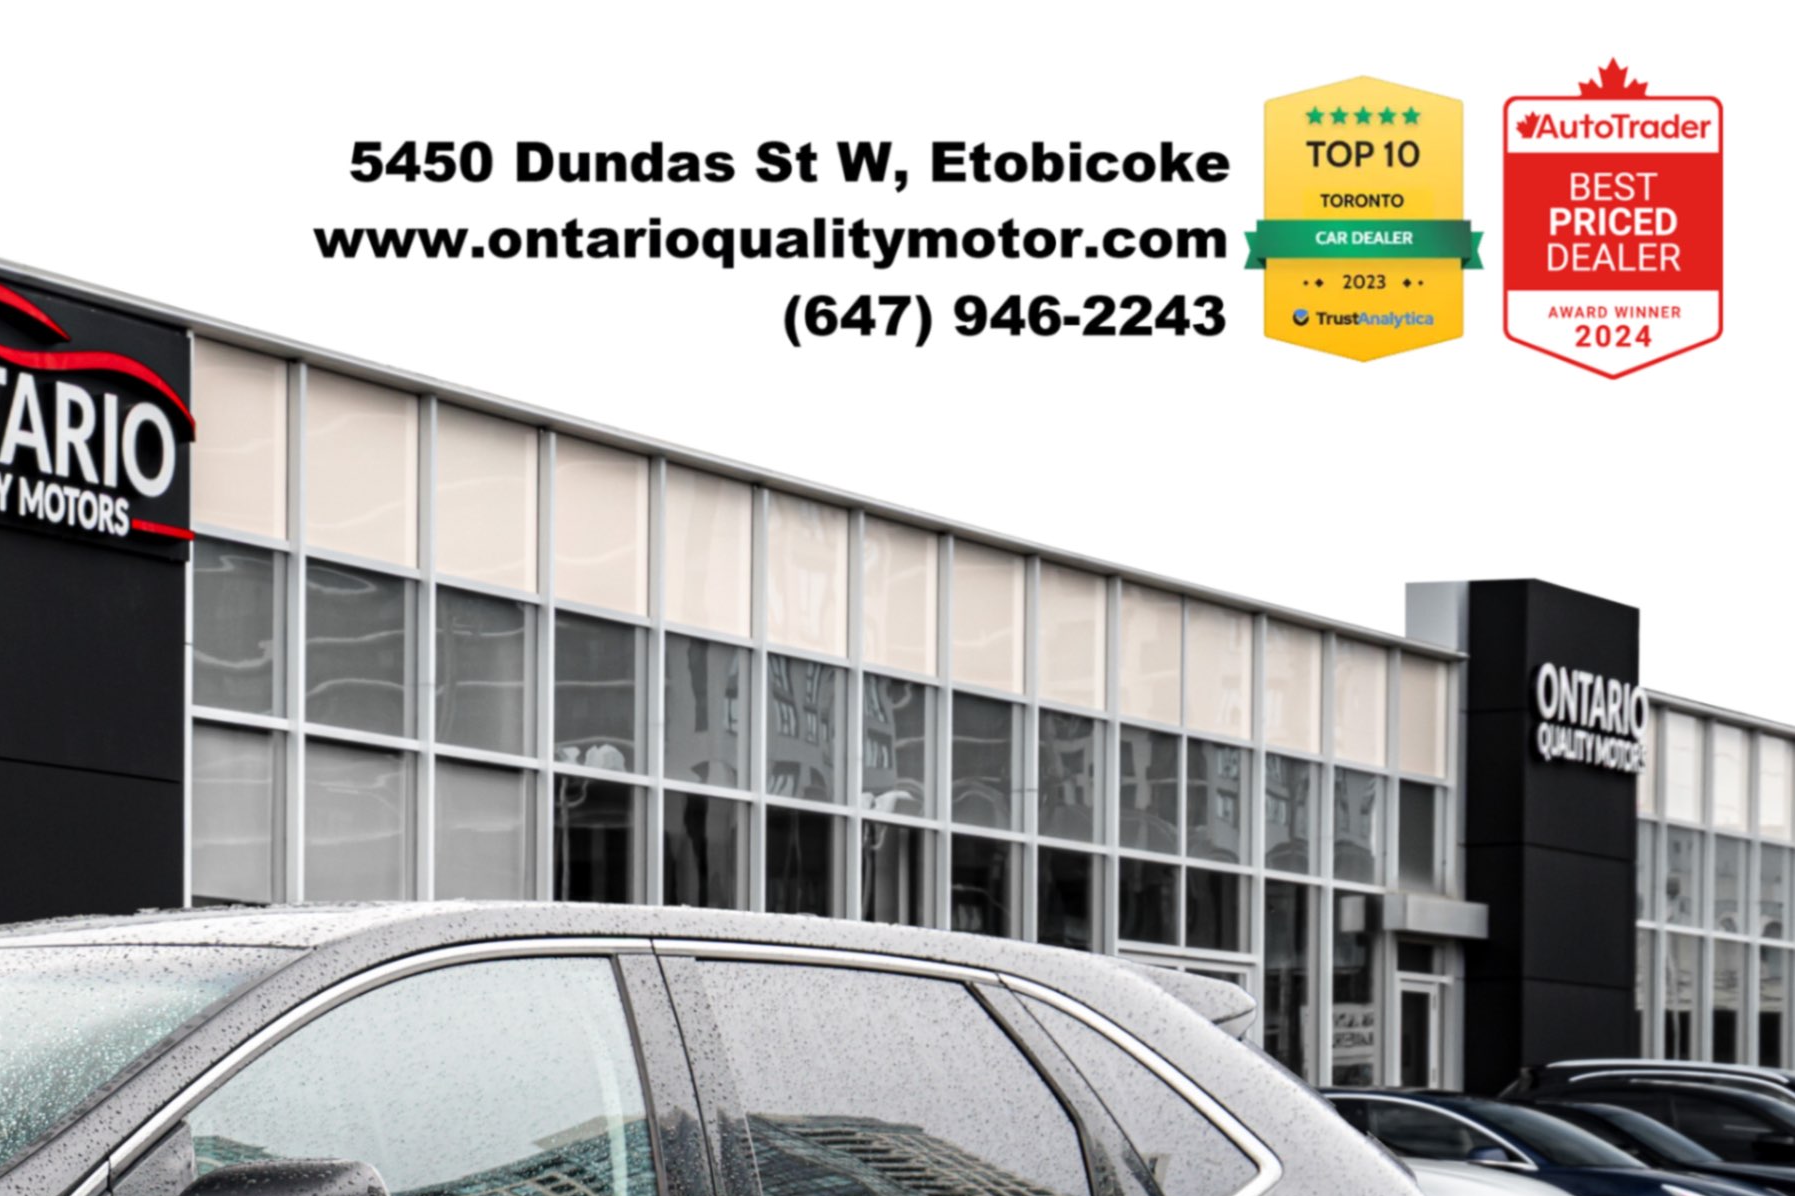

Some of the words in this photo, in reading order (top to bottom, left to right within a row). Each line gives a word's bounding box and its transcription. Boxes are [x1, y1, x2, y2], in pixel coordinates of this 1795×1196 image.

[18, 475, 131, 537] MOTORS
[1536, 661, 1649, 740] ONTARIO
[1536, 721, 1595, 764] QUALITY
